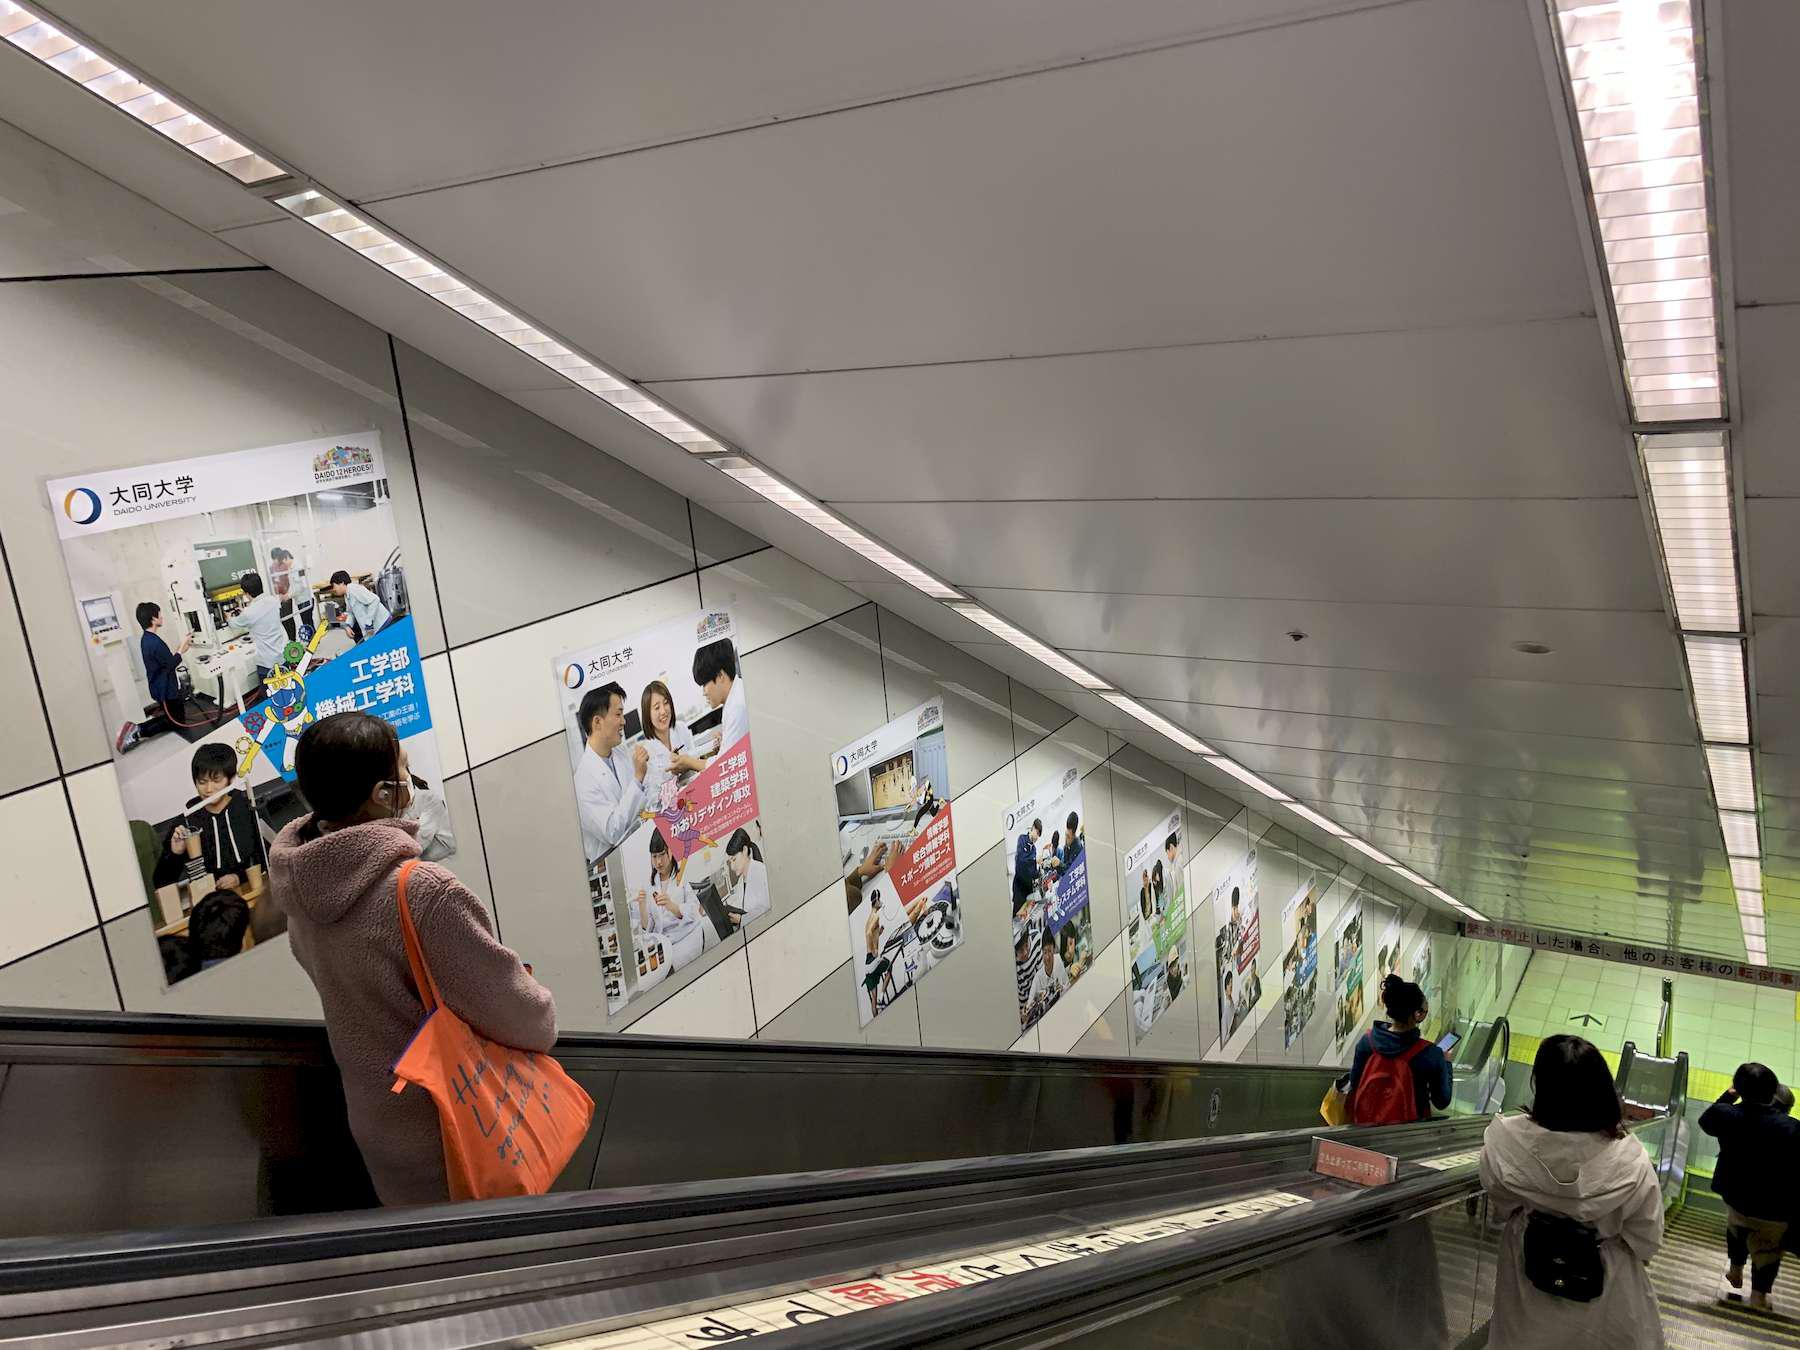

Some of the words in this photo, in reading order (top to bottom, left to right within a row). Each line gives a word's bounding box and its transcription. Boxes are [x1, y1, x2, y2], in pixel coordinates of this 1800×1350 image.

[315, 470, 336, 480] DAIDO
[109, 474, 195, 507] 大同大学
[113, 504, 142, 516] DAIDO
[144, 495, 197, 511] UNIVERSITY
[350, 646, 411, 684] 工学部
[588, 646, 633, 674] 大同大学
[315, 672, 415, 719] 機械工学科
[718, 750, 748, 778] 工学部
